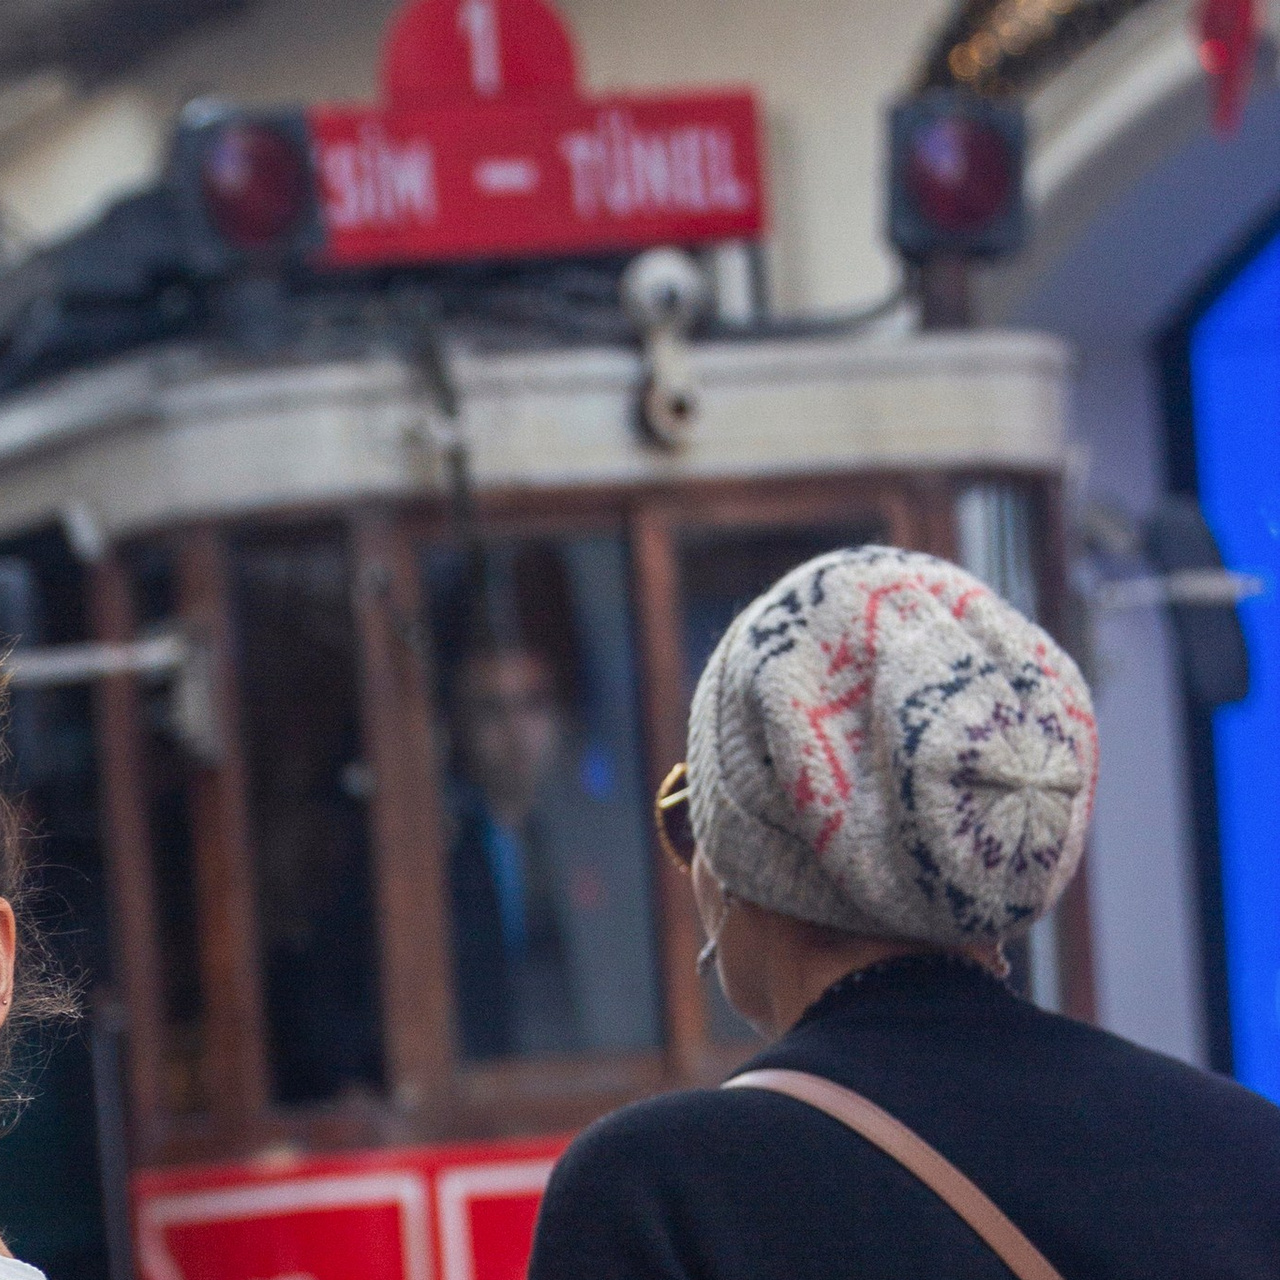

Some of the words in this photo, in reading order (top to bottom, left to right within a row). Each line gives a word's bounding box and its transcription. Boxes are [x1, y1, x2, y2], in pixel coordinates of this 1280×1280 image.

[459, 0, 500, 93] 1
[322, 114, 436, 228] SİM
[562, 110, 750, 218] TÜNEL
